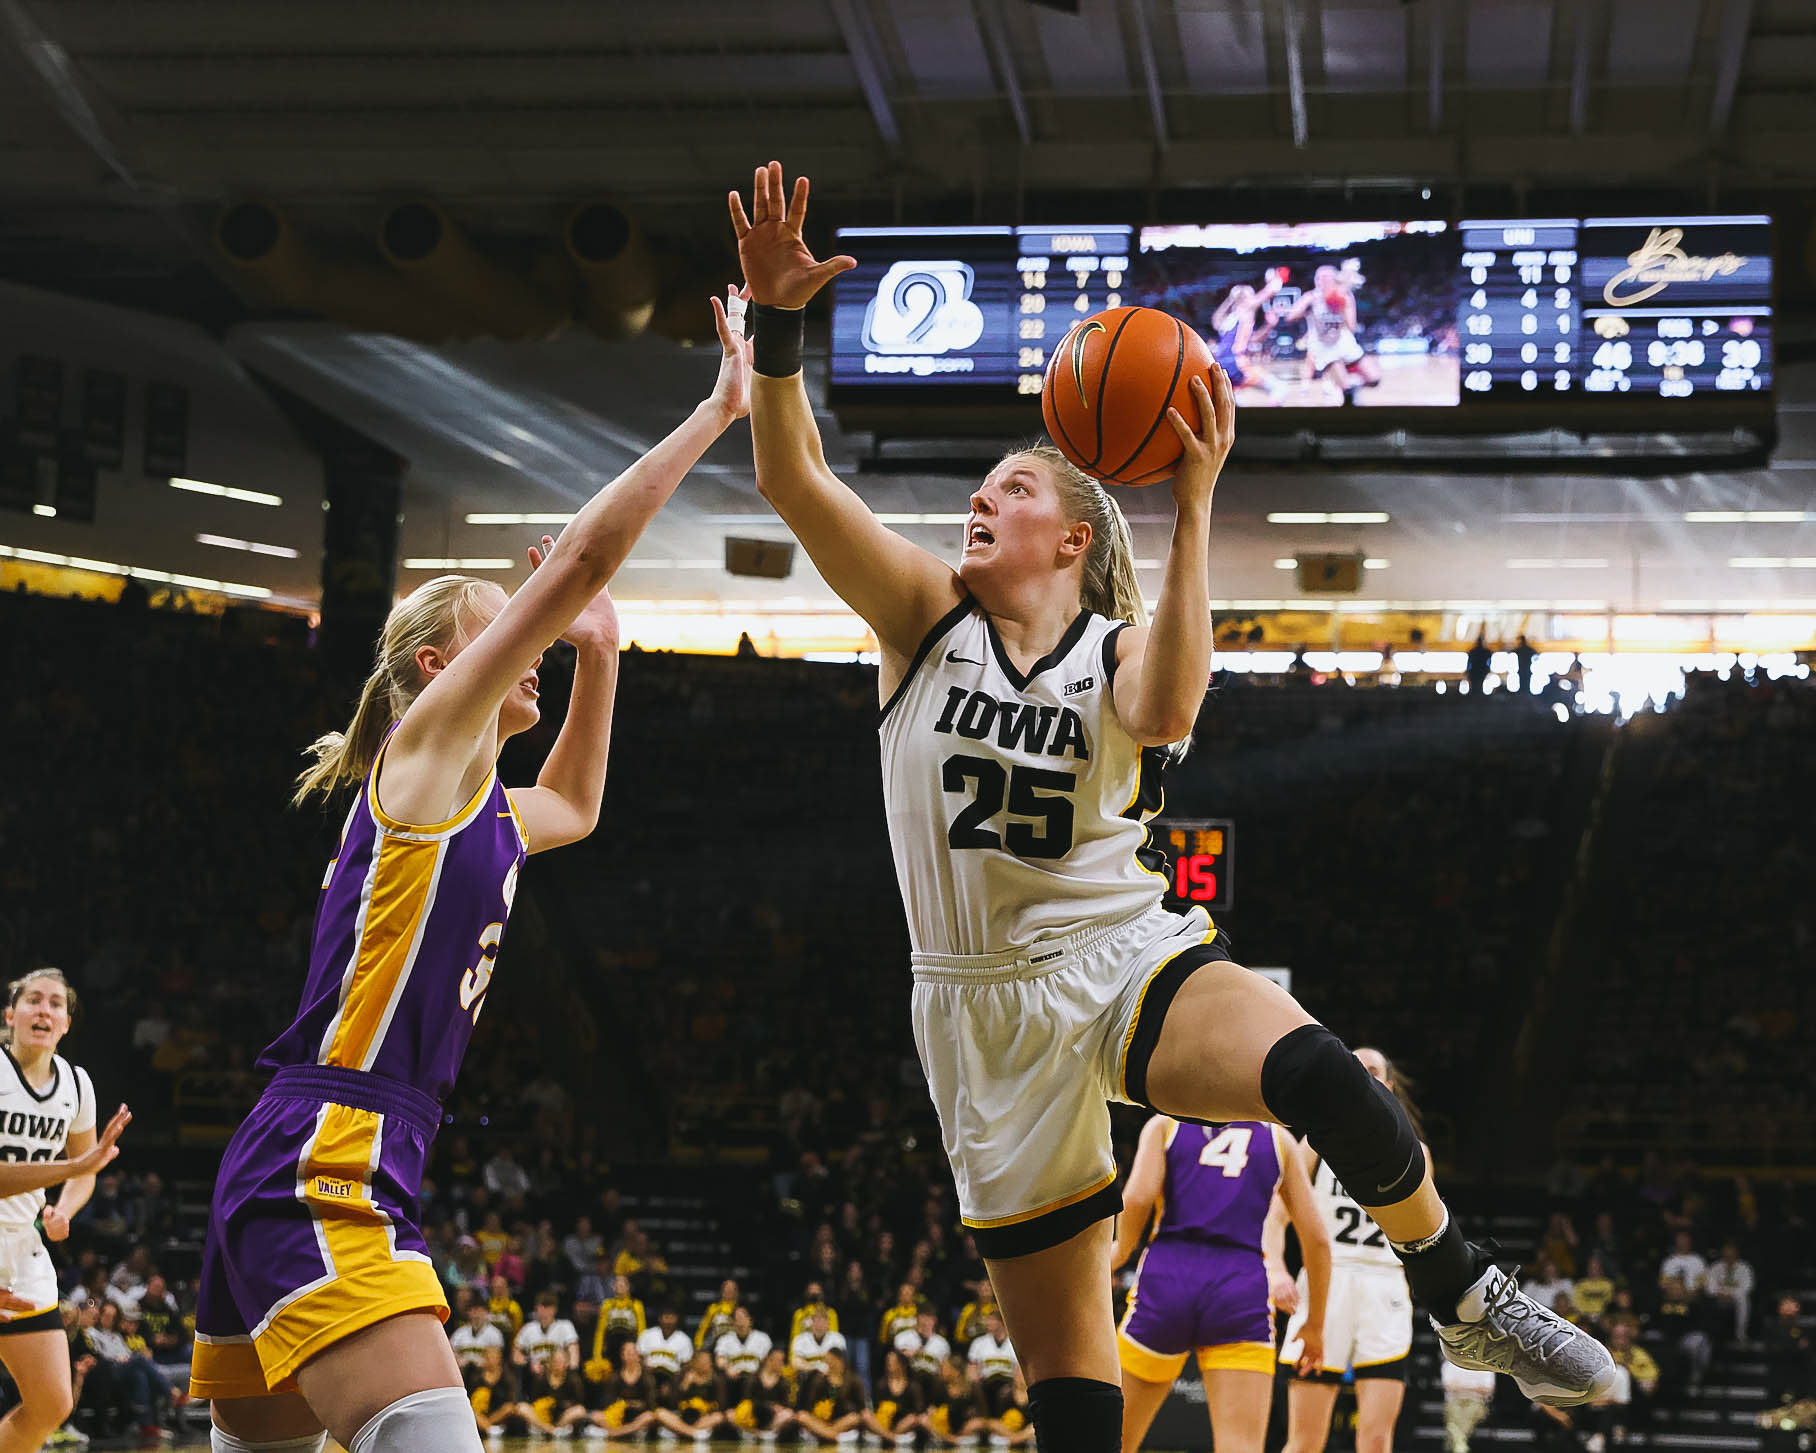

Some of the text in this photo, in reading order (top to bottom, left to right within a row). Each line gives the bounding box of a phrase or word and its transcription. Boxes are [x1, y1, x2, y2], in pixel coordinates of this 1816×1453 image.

[1051, 235, 1097, 252] IOWA
[1470, 287, 1571, 310] 4 4 2
[1555, 342, 1571, 364] 2
[1555, 370, 1570, 391] 2
[934, 686, 1089, 761] IOWA
[942, 753, 1077, 859] 25
[1176, 854, 1217, 901] 15
[459, 921, 504, 1027] 3
[0, 1110, 64, 1141] IOWA
[1198, 1127, 1254, 1178] 4
[318, 1180, 352, 1196] VALLEY
